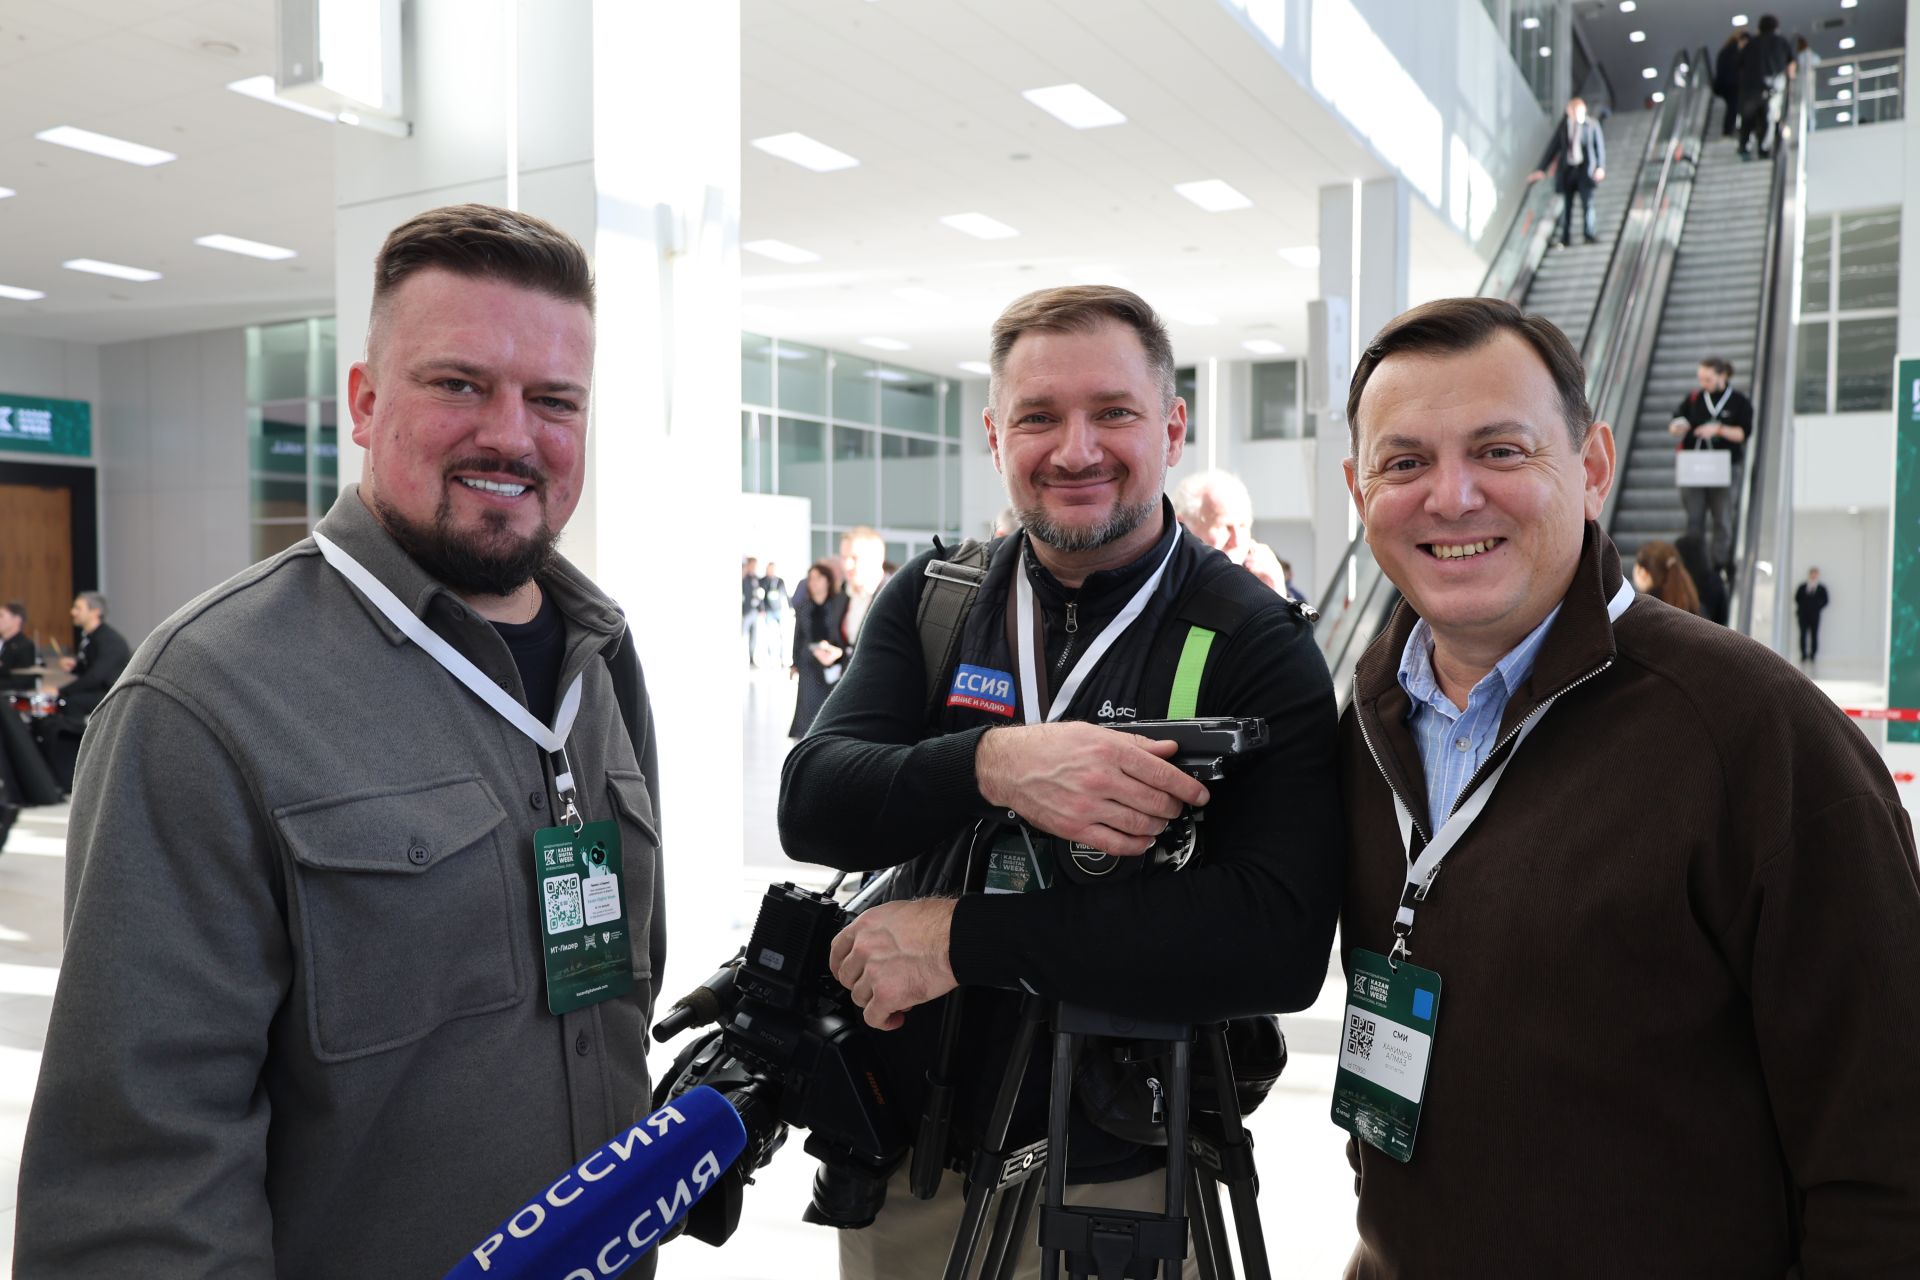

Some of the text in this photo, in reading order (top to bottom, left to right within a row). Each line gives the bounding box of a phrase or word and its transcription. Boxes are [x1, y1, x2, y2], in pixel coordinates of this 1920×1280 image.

[954, 672, 1010, 698] ССИЯ
[980, 700, 1005, 712] РАДИО
[550, 942, 579, 955] ИТ-Лидер
[1369, 984, 1389, 996] DIGITAL
[1370, 978, 1390, 991] KAZAN
[1369, 990, 1388, 1003] WEEK
[1392, 1030, 1409, 1043] СМИ
[473, 1106, 687, 1272] РОССИЯ
